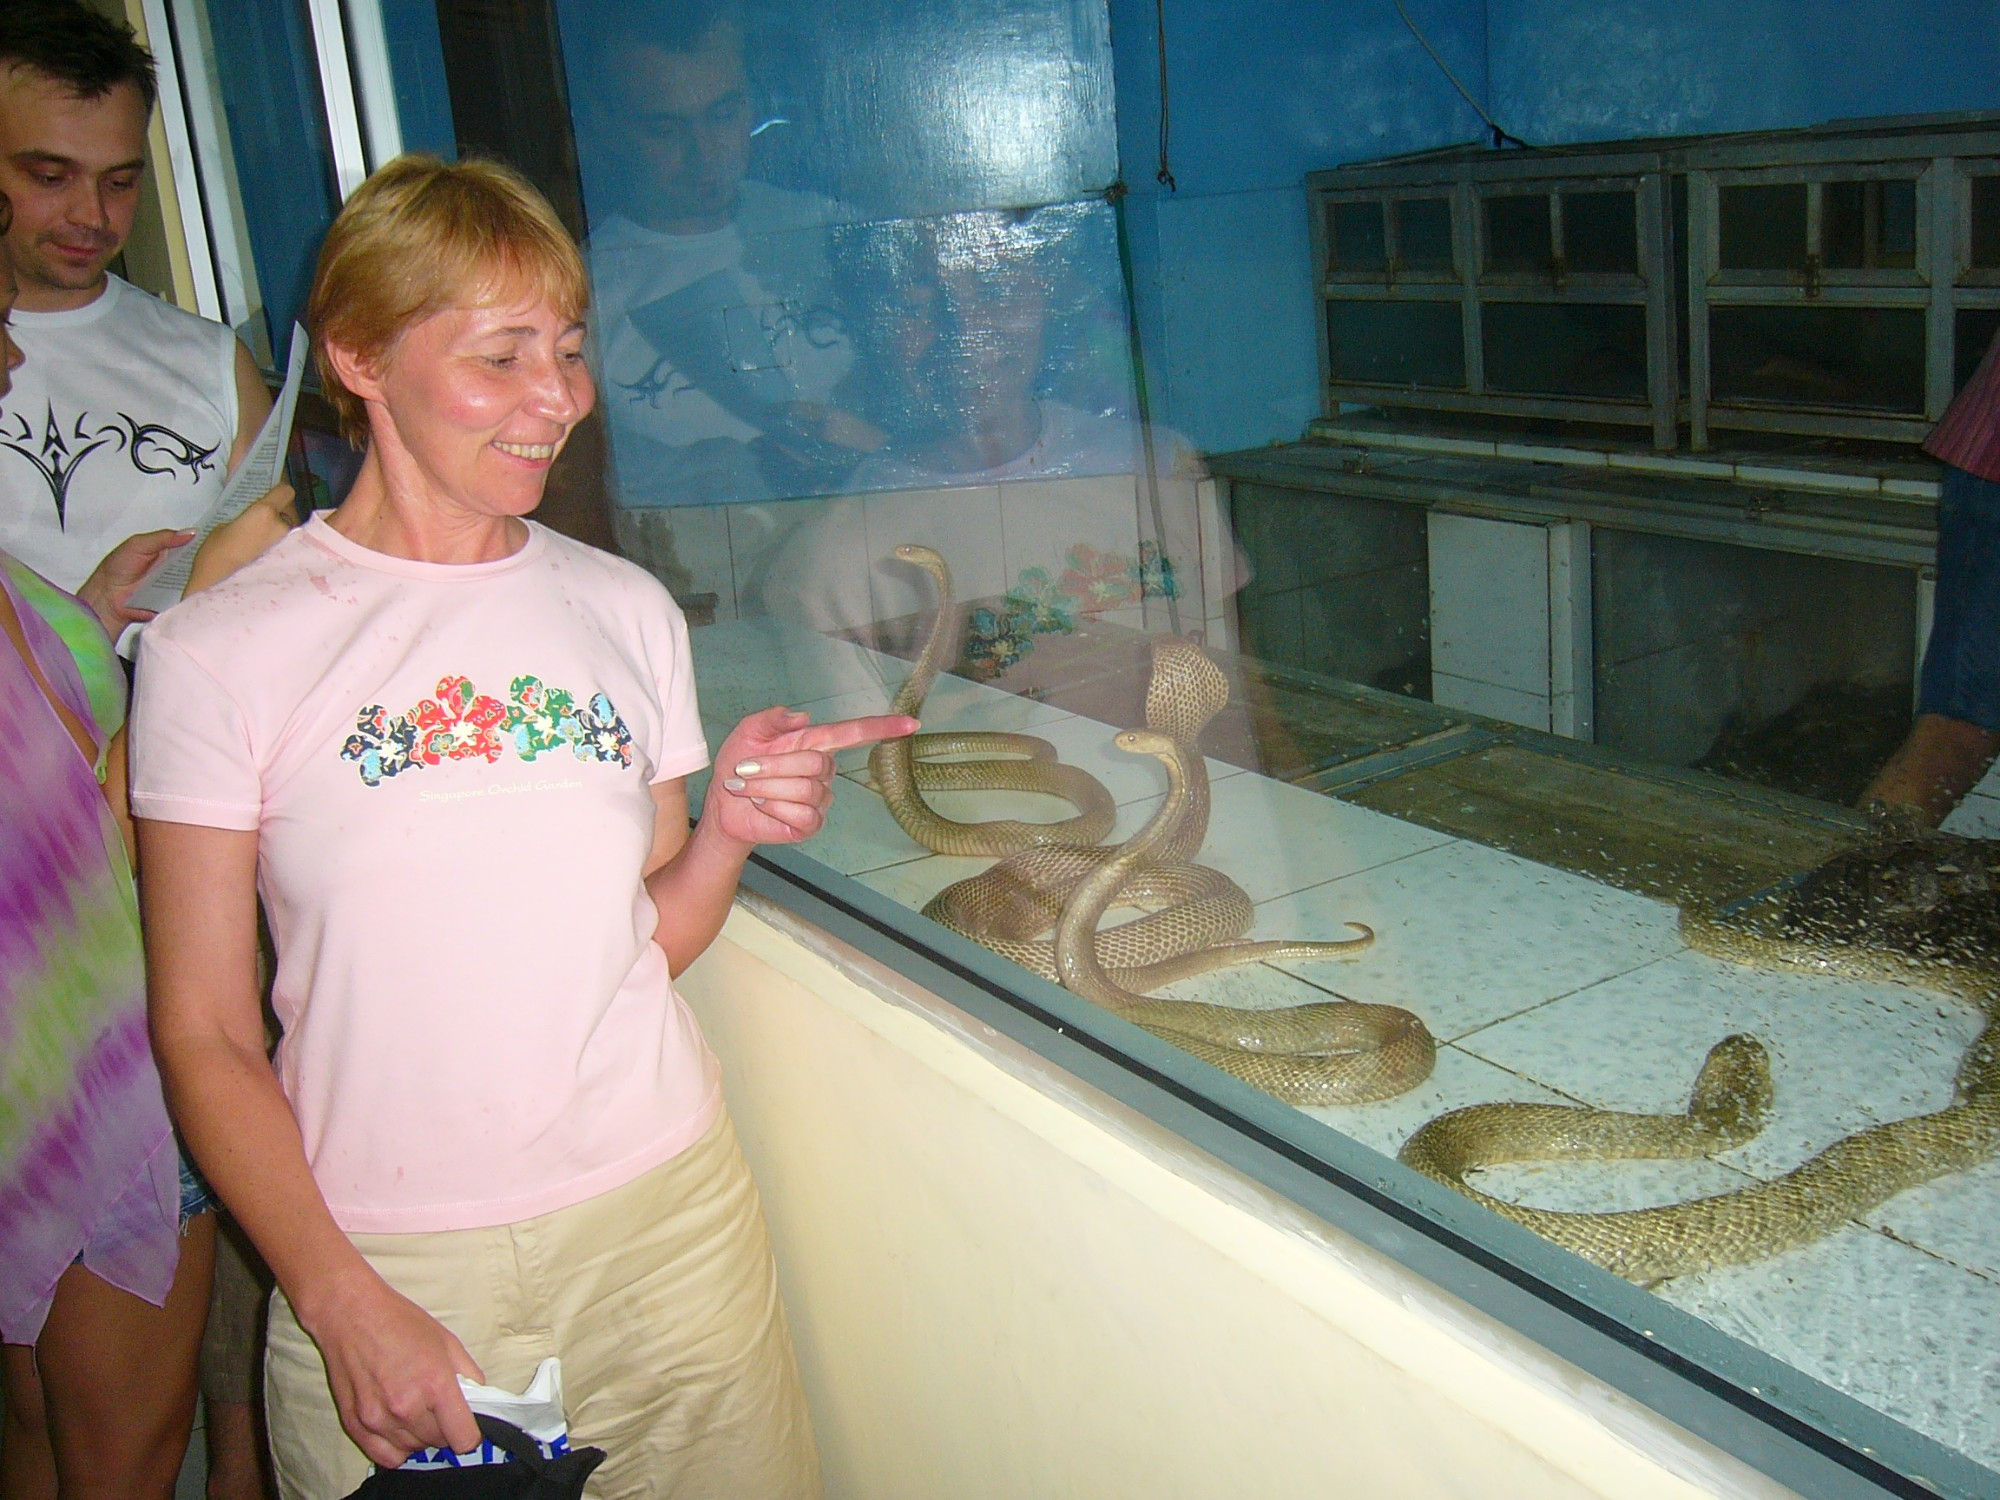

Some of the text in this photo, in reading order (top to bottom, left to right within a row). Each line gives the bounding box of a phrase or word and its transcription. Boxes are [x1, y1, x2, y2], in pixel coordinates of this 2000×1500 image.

[418, 777, 583, 803] Singapore Orchid Garden
